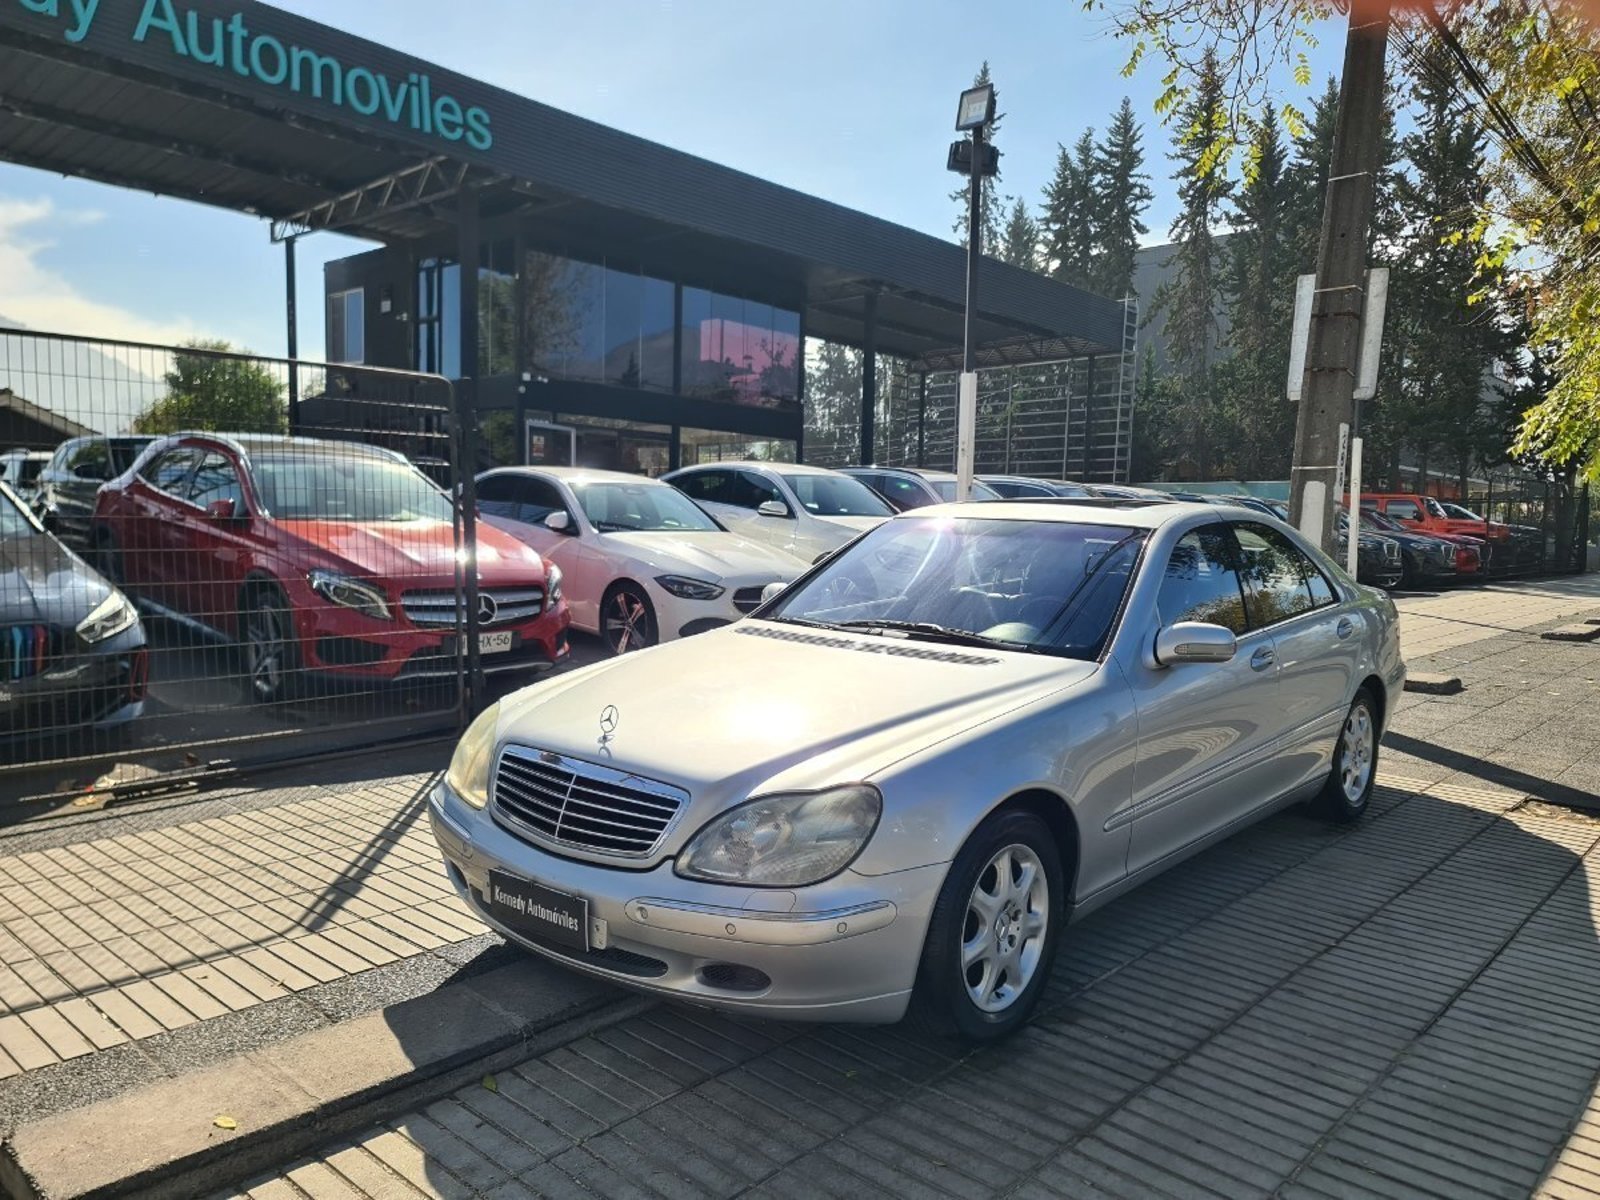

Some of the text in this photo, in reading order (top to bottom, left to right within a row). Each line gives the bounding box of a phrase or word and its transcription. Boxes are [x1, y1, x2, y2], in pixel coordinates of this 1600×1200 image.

[20, 0, 493, 151] y Automoviles
[463, 633, 510, 650] HX-56
[494, 885, 526, 915] Kennedy
